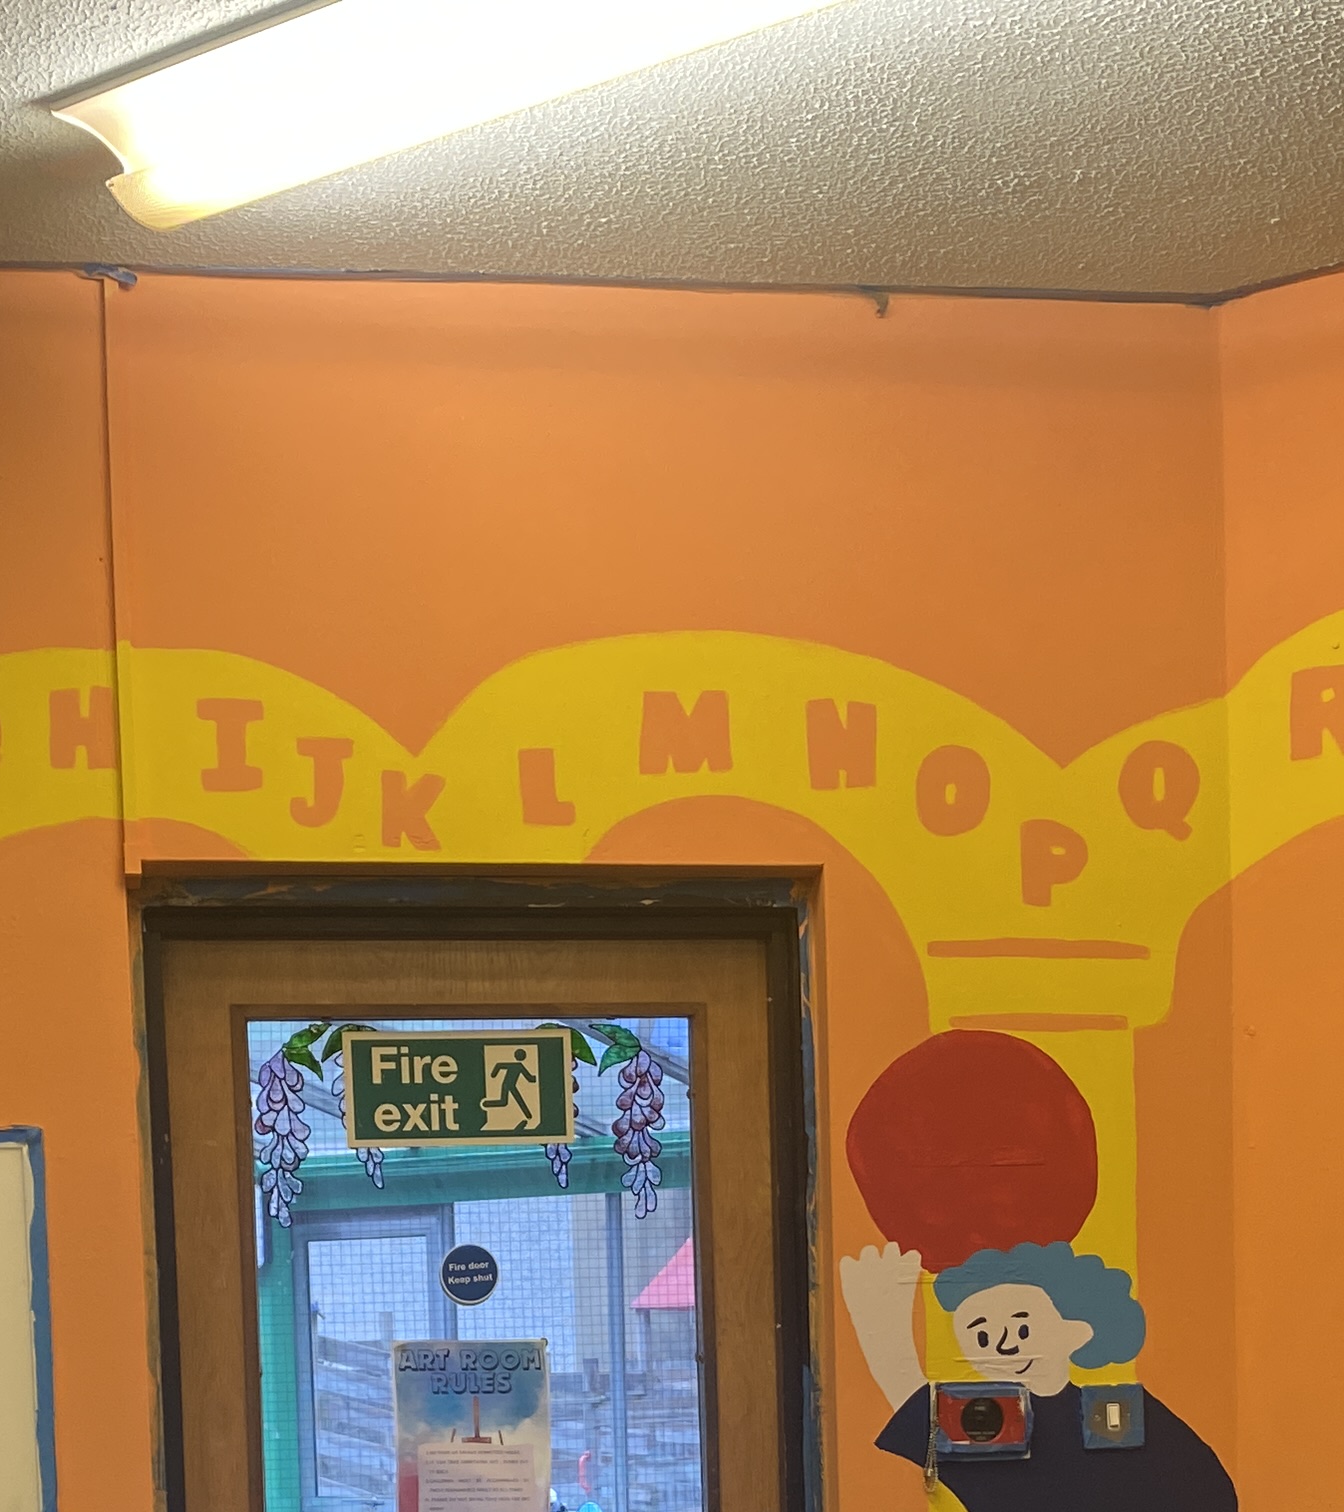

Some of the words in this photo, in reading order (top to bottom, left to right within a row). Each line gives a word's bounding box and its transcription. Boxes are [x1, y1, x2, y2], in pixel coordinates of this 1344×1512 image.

[48, 685, 115, 770] H
[197, 698, 264, 792] I
[289, 737, 354, 828] J
[380, 770, 446, 851] K
[518, 748, 576, 826] L
[639, 690, 733, 775] M
[806, 698, 877, 790] N
[915, 744, 991, 837] O
[1020, 819, 1088, 907] P
[1118, 739, 1200, 842] Q
[370, 1046, 459, 1085] Fire
[373, 1093, 460, 1133] exit
[448, 1263, 466, 1271] Fire
[468, 1261, 489, 1270] door
[447, 1275, 471, 1285] Keep
[473, 1273, 493, 1283] shut
[398, 1348, 450, 1371] ART
[459, 1347, 542, 1371] ROOM
[431, 1371, 512, 1394] RULES
